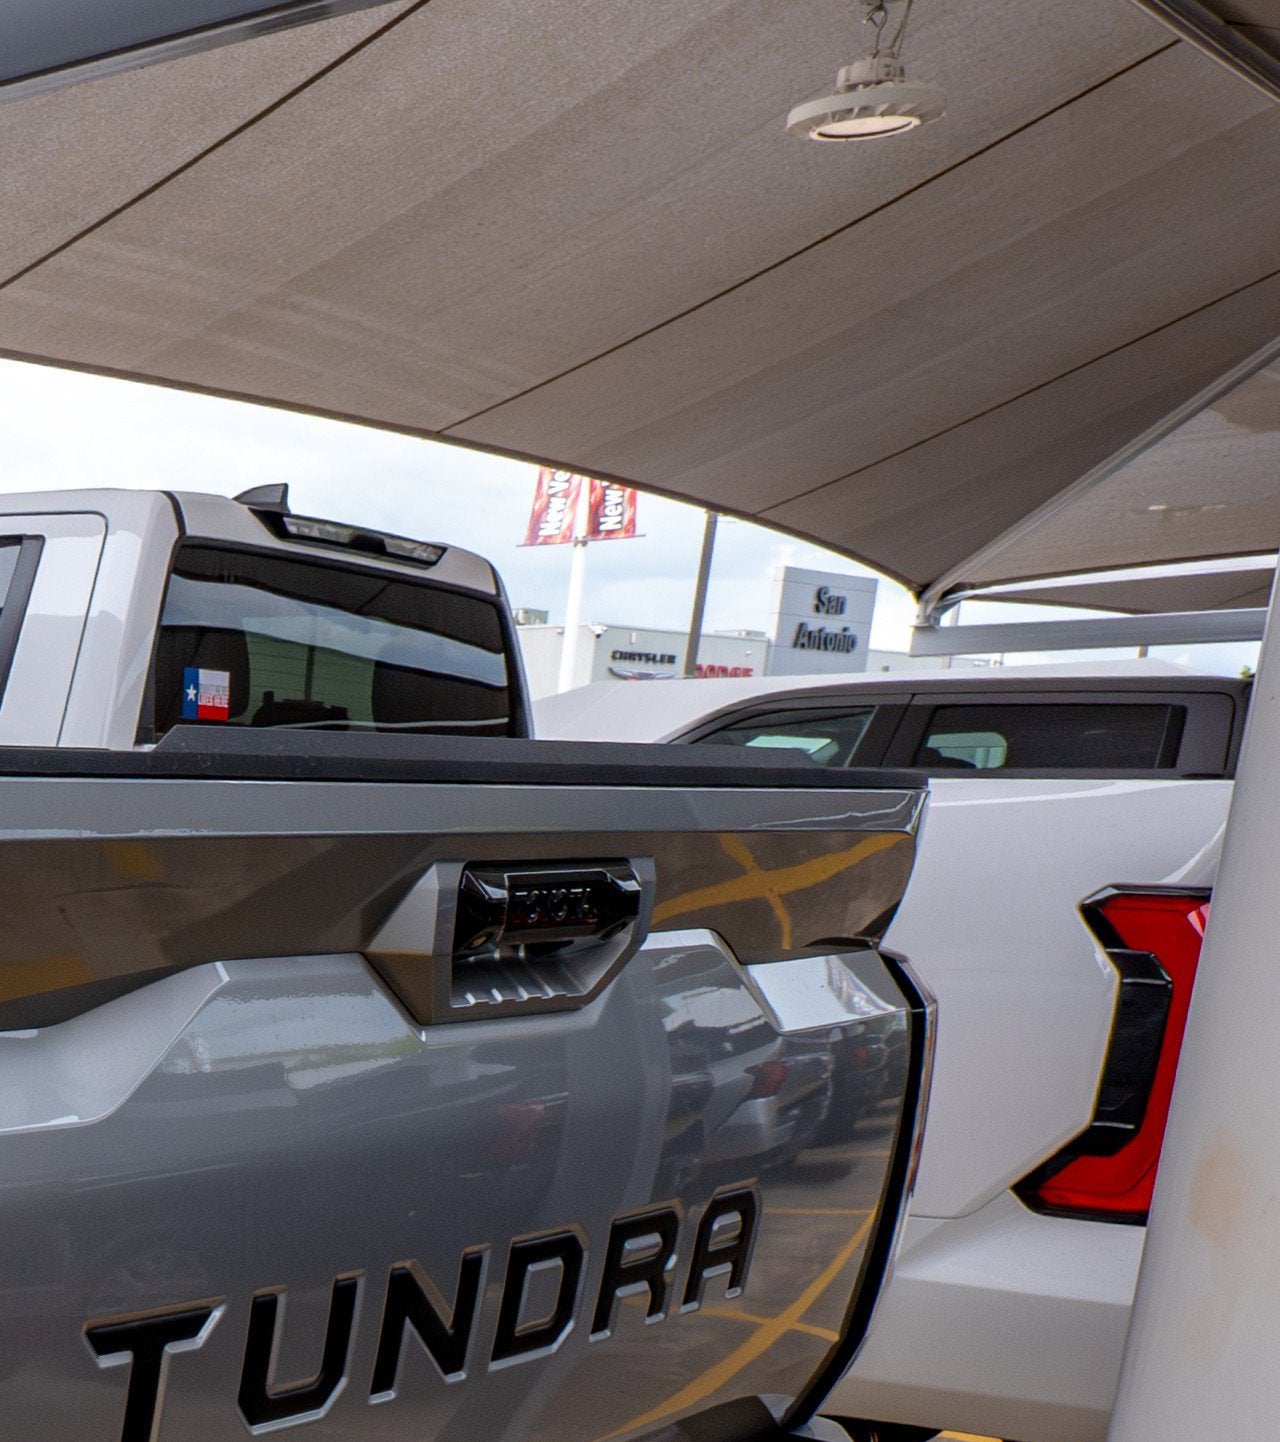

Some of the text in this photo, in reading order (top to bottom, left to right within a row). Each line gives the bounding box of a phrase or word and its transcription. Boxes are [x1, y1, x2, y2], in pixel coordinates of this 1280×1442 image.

[598, 489, 623, 531] New
[814, 586, 846, 615] San
[792, 622, 858, 653] Antonio
[611, 650, 678, 664] CHRYSLER
